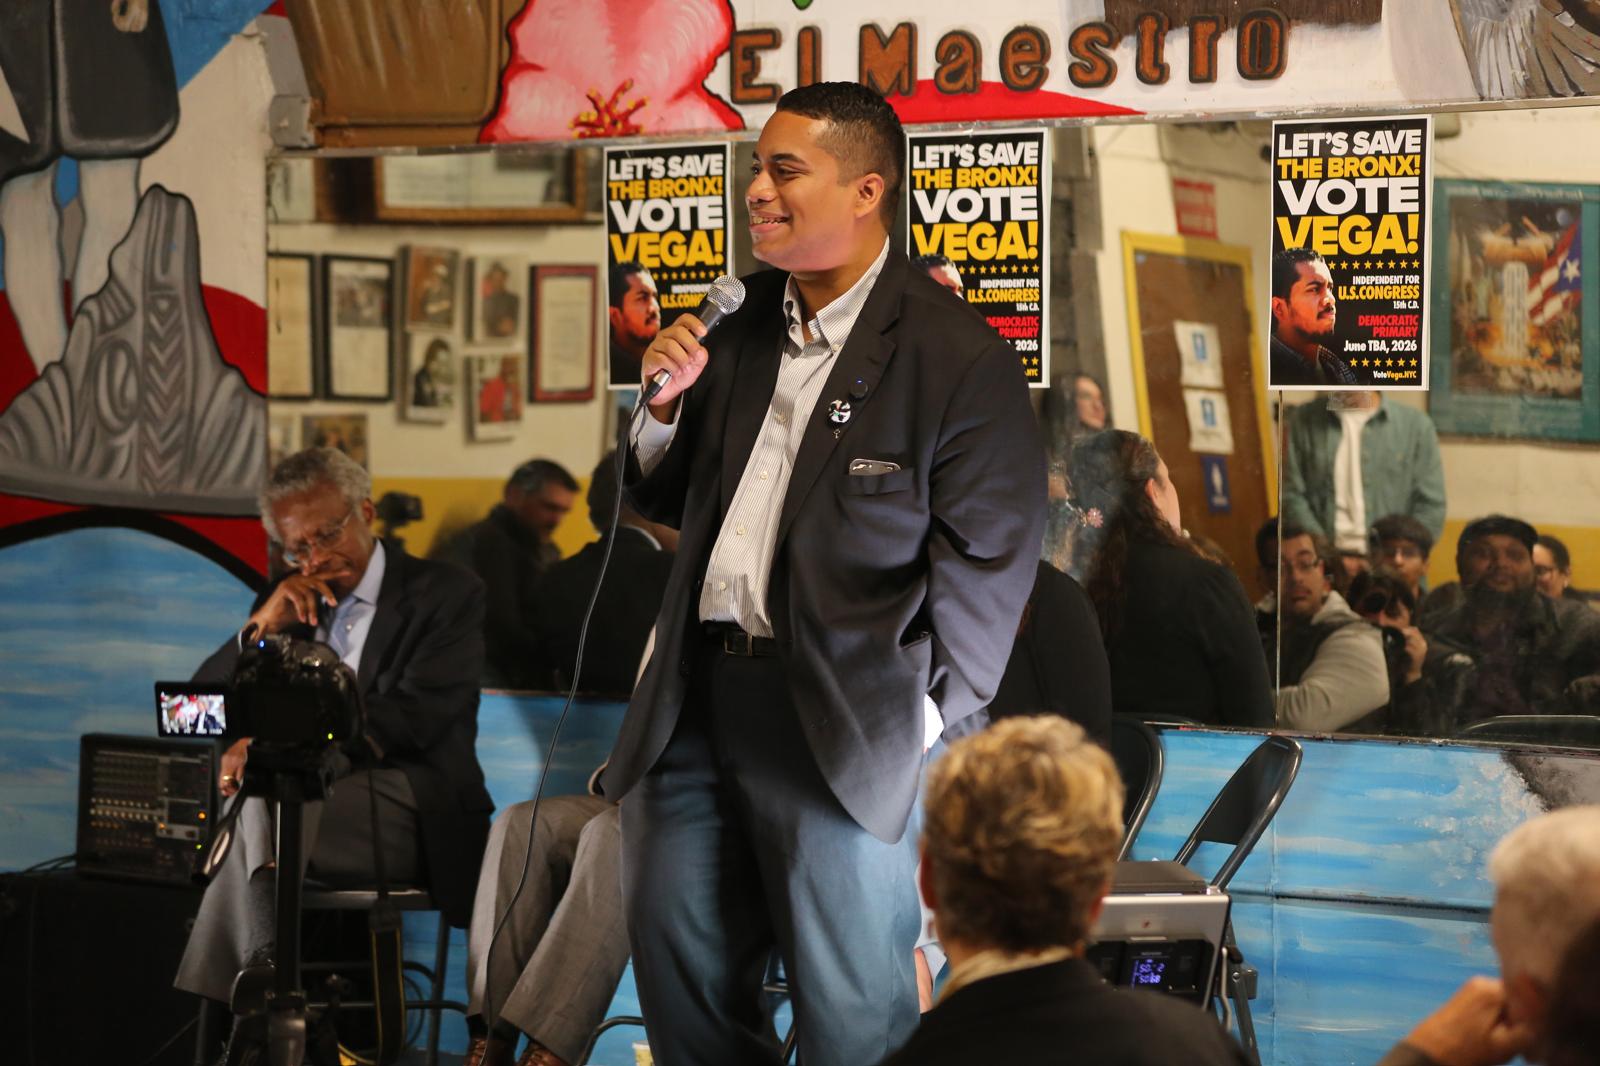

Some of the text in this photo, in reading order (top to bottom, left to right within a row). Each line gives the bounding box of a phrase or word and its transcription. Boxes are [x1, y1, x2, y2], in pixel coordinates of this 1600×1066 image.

[859, 9, 1291, 97] Maestro
[913, 141, 1039, 169] LET'S SAVE
[1278, 129, 1422, 157] LET'S SAVE
[609, 154, 723, 180] LET'S SAVE
[912, 166, 1038, 189] THE BRONX!
[1277, 155, 1421, 179] THE BRONX!
[608, 176, 723, 200] THE BRONX!
[1278, 177, 1419, 215] VOTE
[608, 196, 723, 233] VOTE
[913, 186, 1038, 223] VOTE
[911, 221, 1039, 261] VEGA!
[1276, 214, 1420, 256] VEGA!
[609, 229, 724, 268] VEGA!
[980, 278, 1039, 289] INDEPENDENT FOR
[1353, 275, 1420, 285] INDEPENDENT FOR
[967, 288, 1040, 303] U.S.CONGRESS
[1338, 285, 1420, 300] U.S.CONGRESS
[1393, 301, 1419, 309] 15th C.D.
[999, 327, 1039, 338] PRIMARY
[1358, 315, 1419, 326] DEMOCRATIC
[1373, 326, 1419, 337] PRIMARY
[1015, 339, 1038, 351] 2026
[1344, 340, 1417, 354] June TBA, 2026
